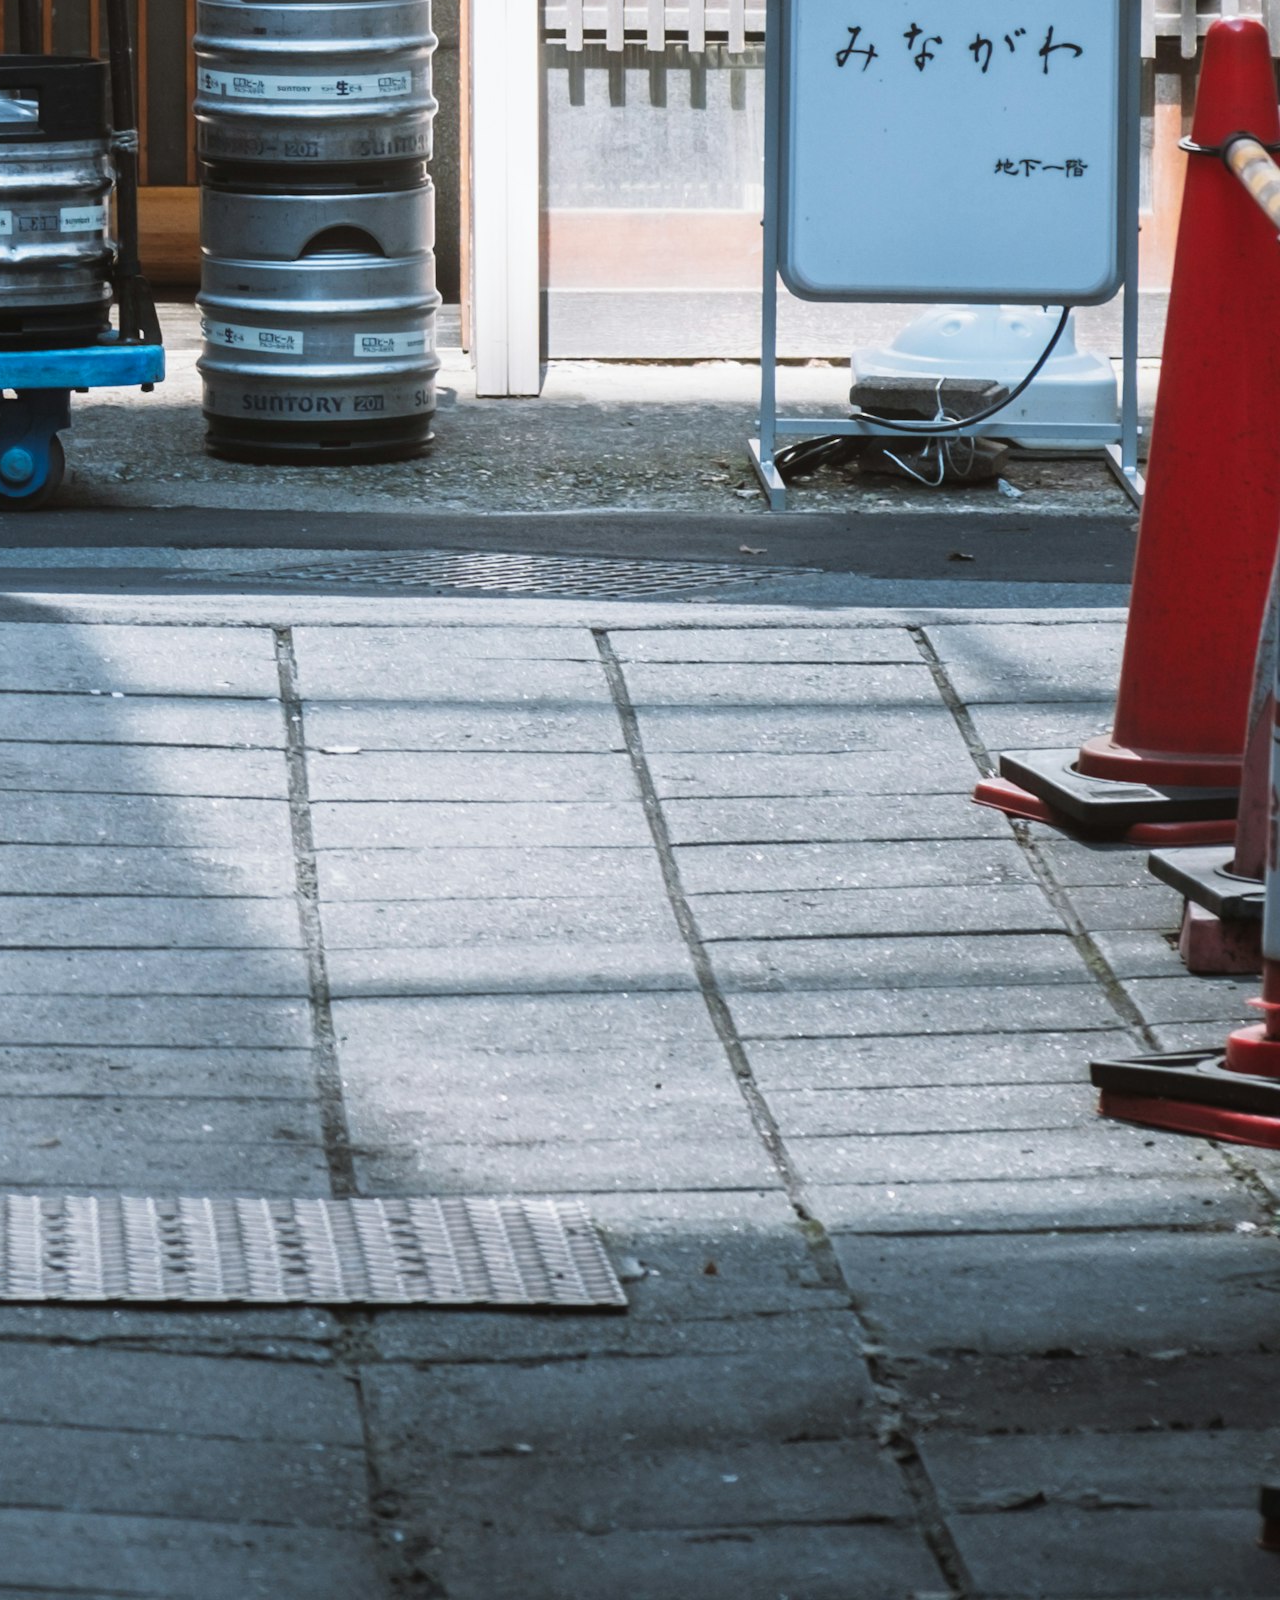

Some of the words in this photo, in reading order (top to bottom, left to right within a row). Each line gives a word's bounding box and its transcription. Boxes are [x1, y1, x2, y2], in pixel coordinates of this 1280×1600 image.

[835, 22, 1084, 75] みながわ
[993, 158, 1089, 178] 地下一階
[242, 394, 344, 413] SUNTORY
